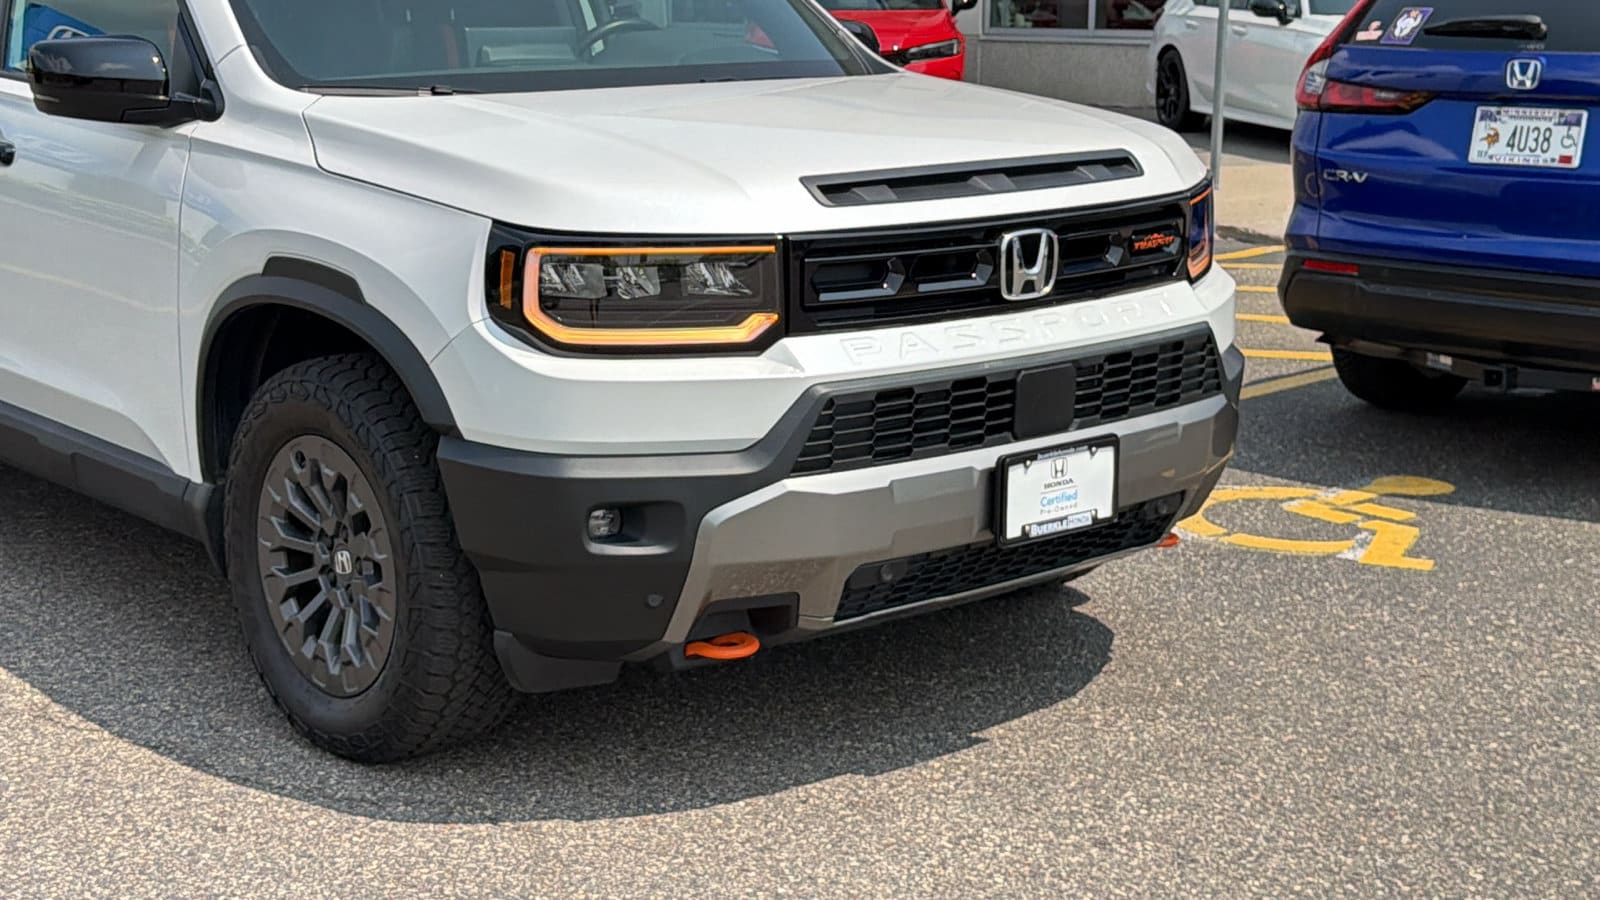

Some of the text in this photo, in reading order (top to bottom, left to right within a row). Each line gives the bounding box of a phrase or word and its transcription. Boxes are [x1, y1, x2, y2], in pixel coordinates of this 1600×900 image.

[1506, 125, 1552, 154] 4U38
[839, 292, 1173, 364] PASSPORT
[1044, 477, 1074, 489] HONDA
[1040, 490, 1078, 507] Certified
